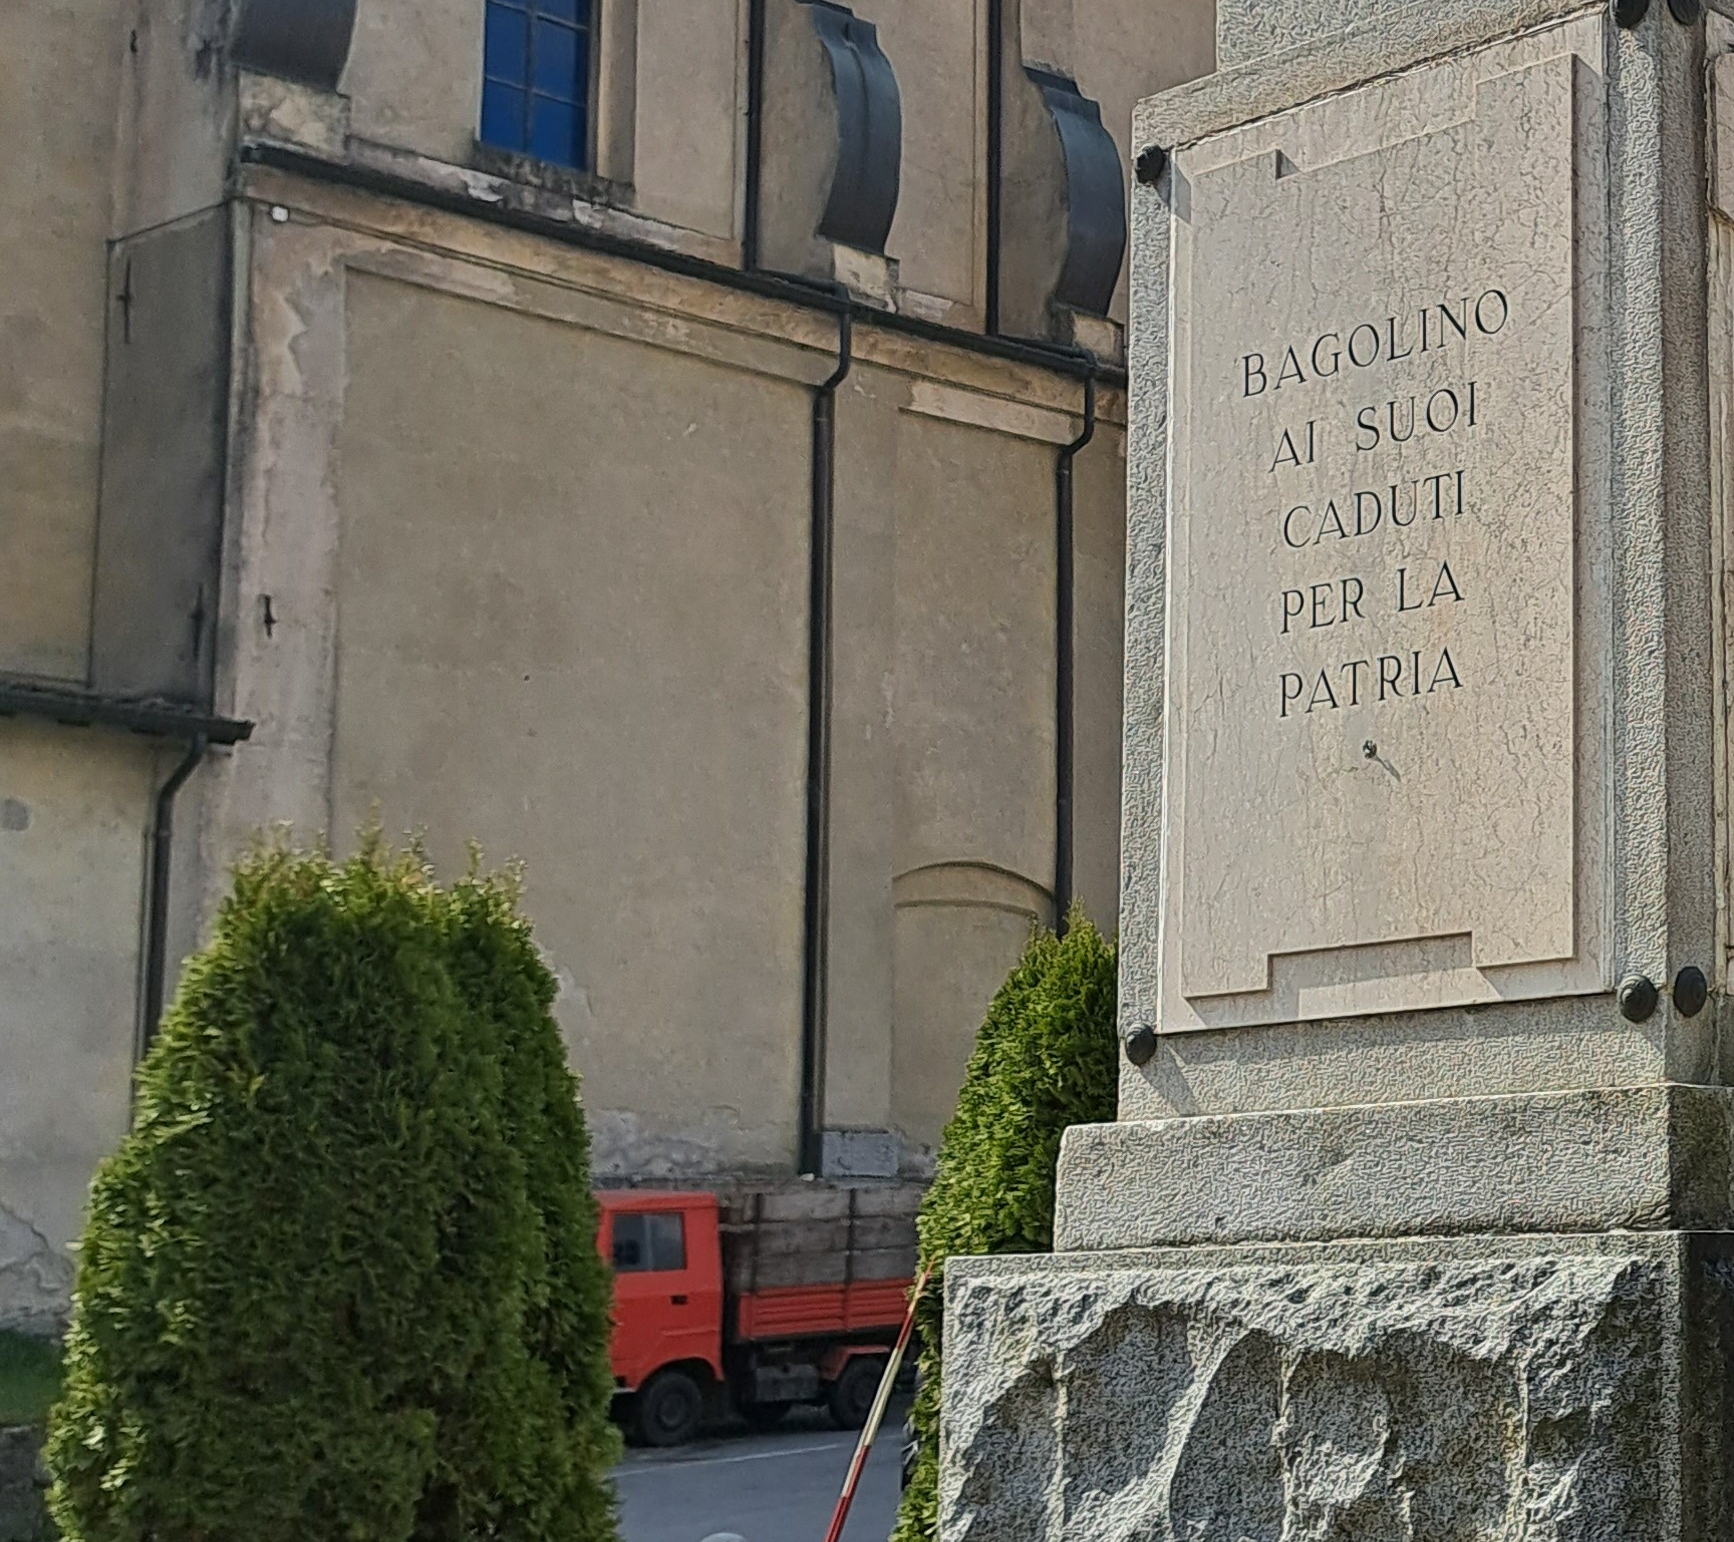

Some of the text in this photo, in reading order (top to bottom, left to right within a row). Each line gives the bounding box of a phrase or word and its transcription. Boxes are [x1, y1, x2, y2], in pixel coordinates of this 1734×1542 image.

[1241, 288, 1511, 399] BAGOLINO
[1268, 381, 1478, 474] AI SUOI
[1284, 469, 1466, 551] CADUTI
[1280, 561, 1466, 635] PER LA
[1278, 647, 1464, 719] PATRIA
